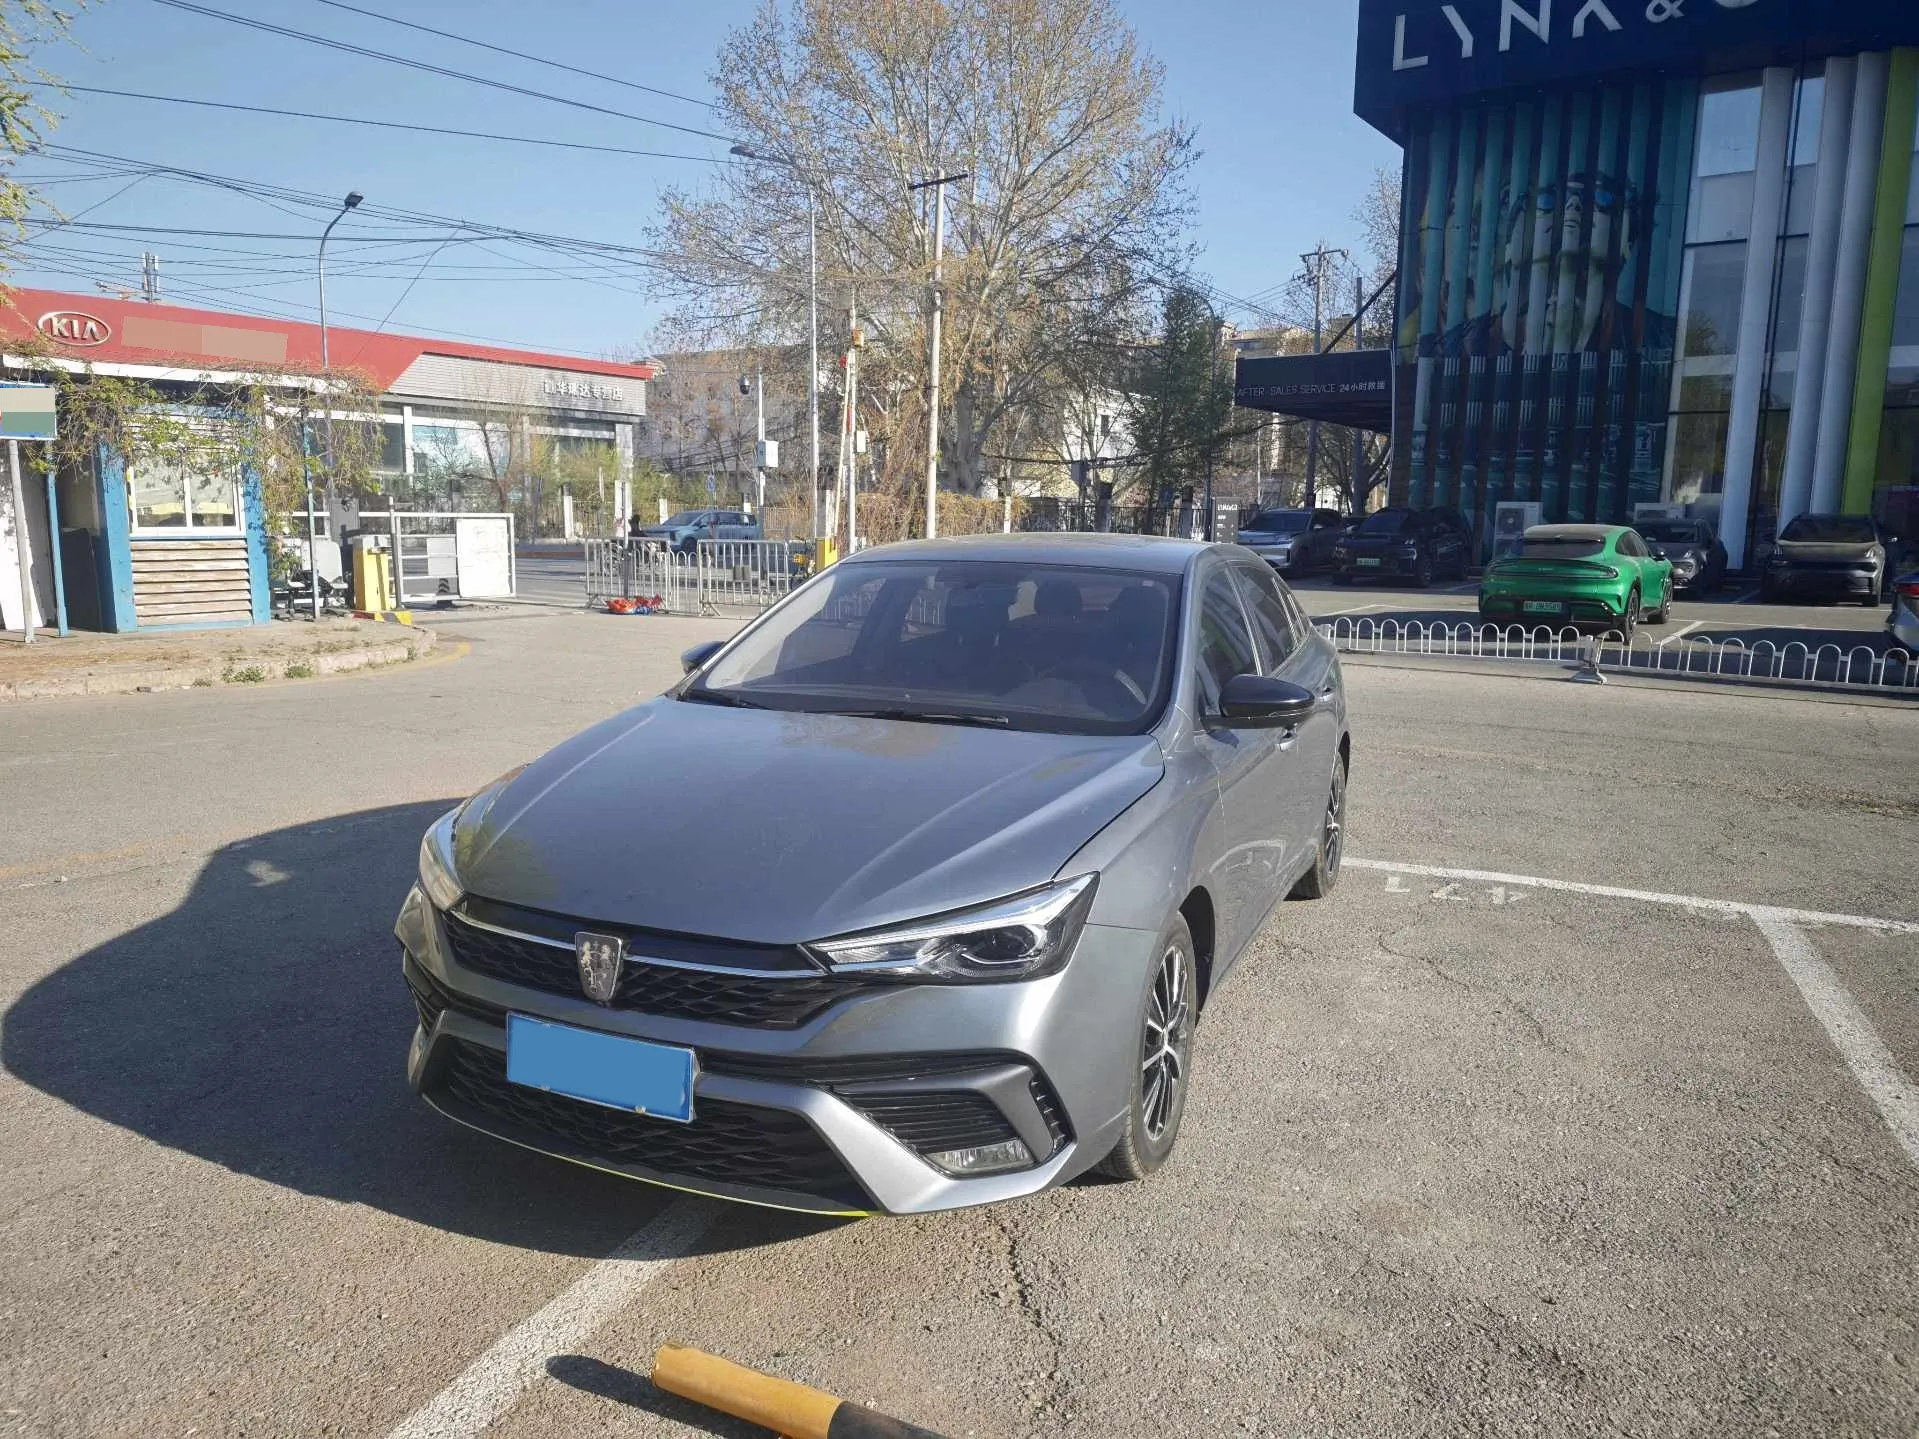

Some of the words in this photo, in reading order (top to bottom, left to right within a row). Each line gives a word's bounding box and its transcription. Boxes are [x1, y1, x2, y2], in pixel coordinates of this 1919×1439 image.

[51, 316, 101, 341] KIA
[1270, 385, 1298, 396] SALES
[1300, 383, 1336, 394] SERVICE
